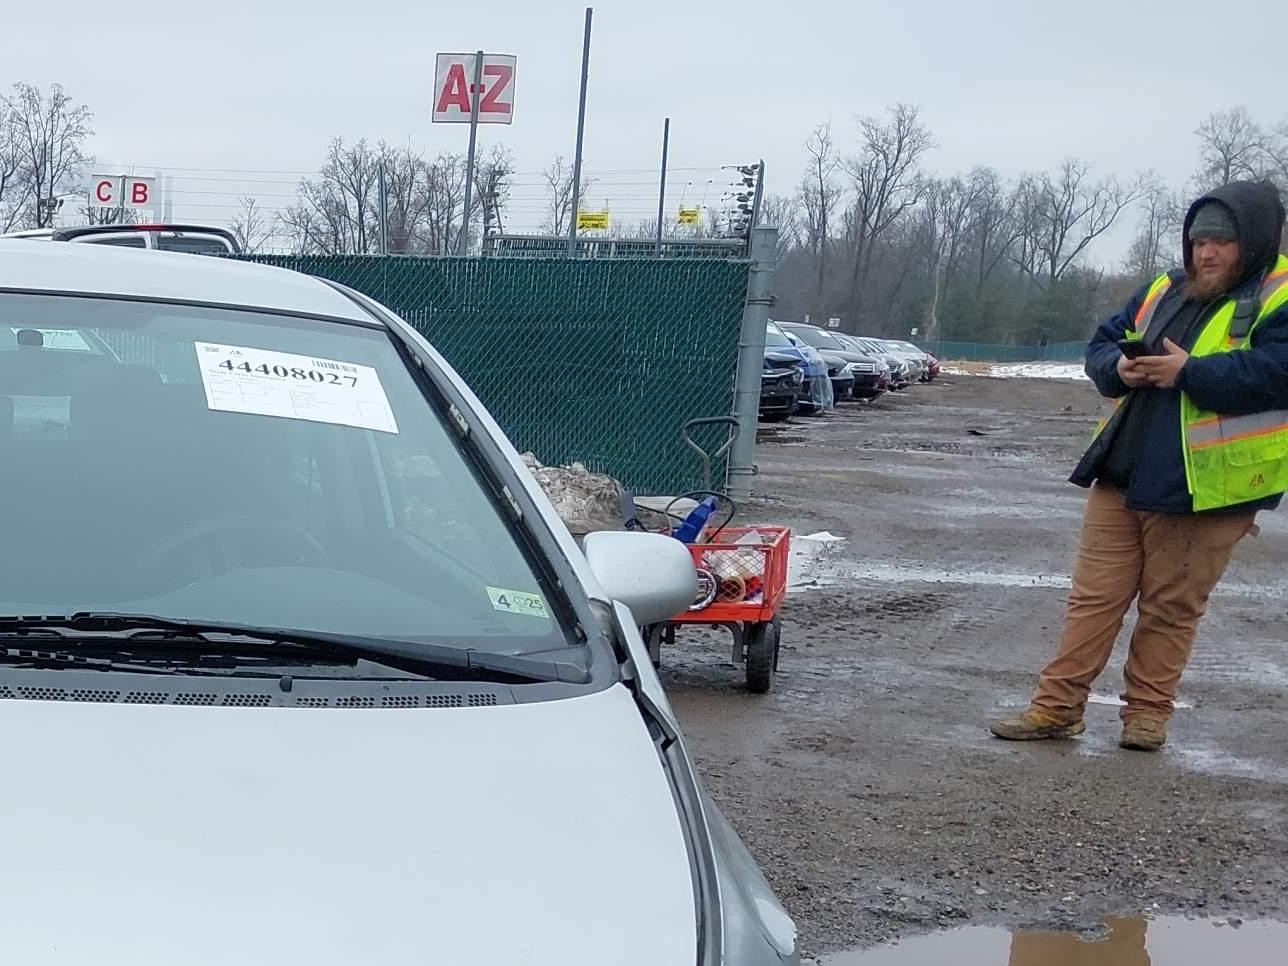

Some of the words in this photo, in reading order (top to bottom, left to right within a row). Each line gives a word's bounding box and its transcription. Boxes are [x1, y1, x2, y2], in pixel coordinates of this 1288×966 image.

[435, 63, 513, 113] A-Z
[96, 180, 113, 202] C
[131, 182, 148, 204] B
[218, 358, 359, 388] 44408027
[497, 593, 512, 609] 4
[525, 597, 544, 610] 25
